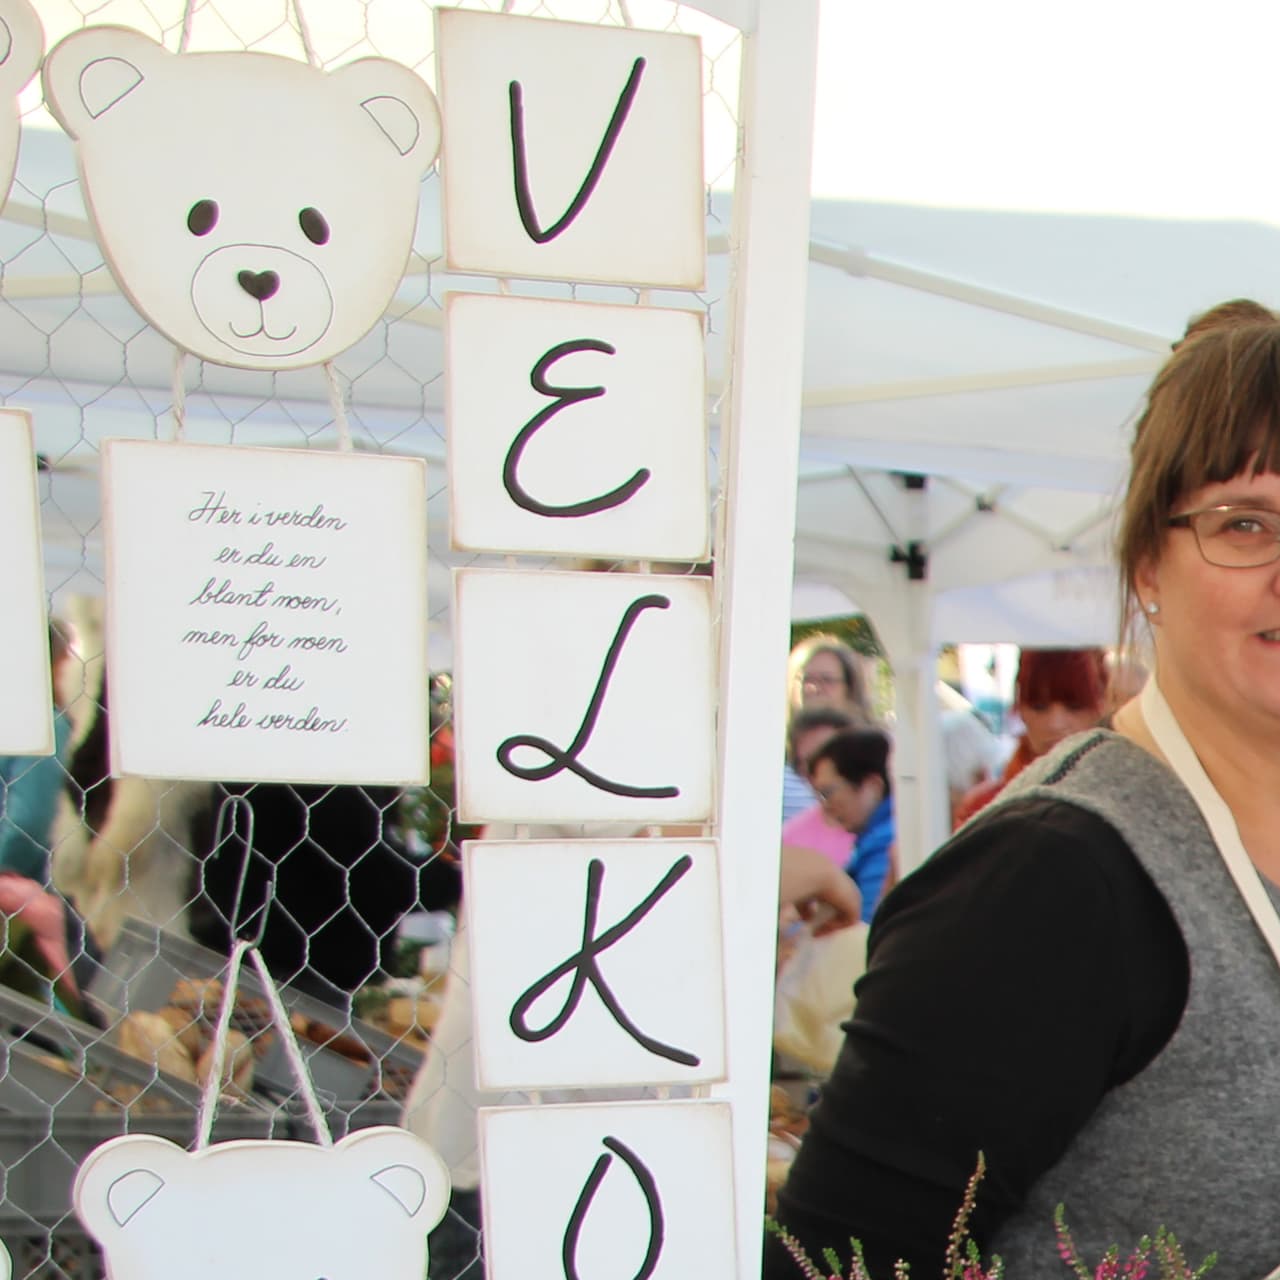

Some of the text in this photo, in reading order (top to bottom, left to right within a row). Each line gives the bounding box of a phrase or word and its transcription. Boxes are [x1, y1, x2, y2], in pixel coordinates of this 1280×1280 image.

[188, 490, 347, 530] Her i verden
[214, 542, 327, 569] er du en
[190, 577, 342, 616] blant noen,
[182, 621, 348, 661] men for noen
[227, 664, 304, 691] er du
[197, 699, 252, 728] hele
